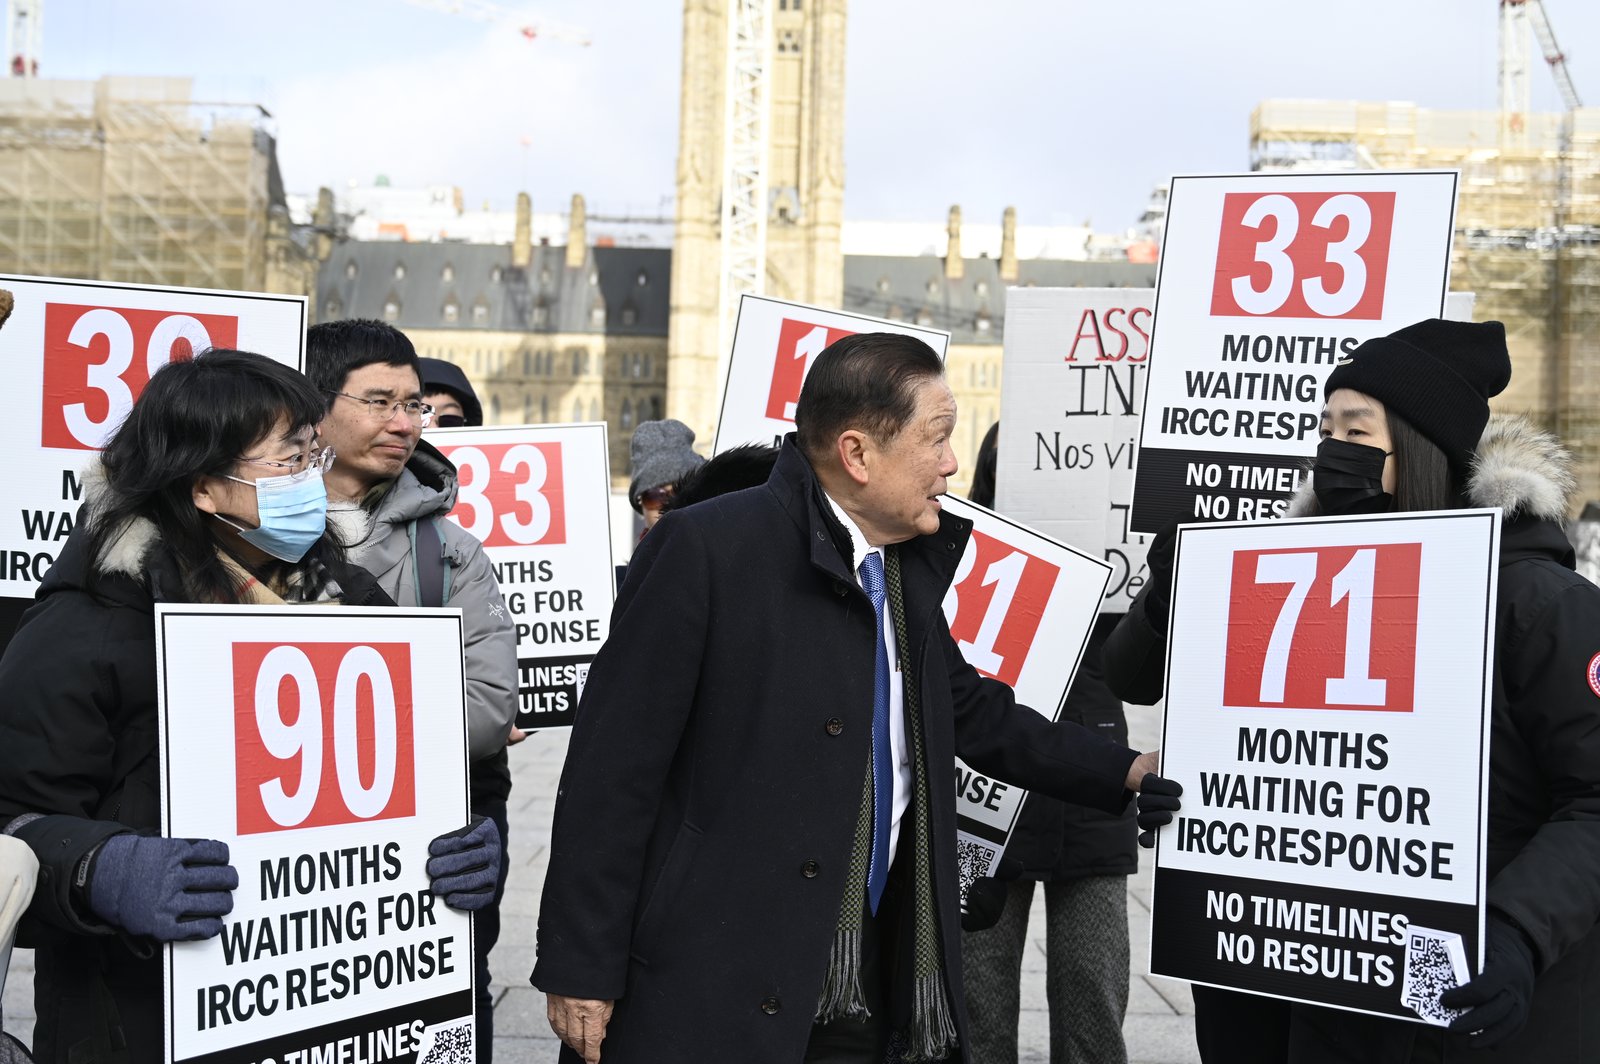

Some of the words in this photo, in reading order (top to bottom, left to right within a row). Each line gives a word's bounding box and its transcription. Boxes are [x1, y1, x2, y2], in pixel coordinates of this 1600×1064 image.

[1231, 194, 1372, 316] 33
[1221, 334, 1359, 365] MONTHS
[1185, 370, 1317, 403] WAITING
[1160, 406, 1229, 437] IRCC
[1034, 431, 1093, 471] Nos
[1186, 463, 1222, 487] NO
[447, 444, 551, 544] 33
[1194, 494, 1230, 519] NO
[534, 589, 583, 613] FOR
[516, 619, 601, 645] PONSE
[1255, 548, 1387, 707] 71
[518, 665, 577, 688] LINES
[519, 691, 569, 714] ULTS
[254, 645, 397, 827] 90
[1237, 727, 1389, 771] MONTHS
[1199, 772, 1343, 818] WAITING
[1356, 783, 1431, 826] FOR
[260, 842, 401, 901] MONTHS
[1177, 817, 1249, 858] IRCC
[1254, 828, 1454, 881] RESPONSE
[219, 901, 368, 965] WAITING
[378, 890, 436, 937] FOR
[1206, 889, 1244, 922] NO
[1251, 895, 1410, 947] TIMELINES
[197, 973, 279, 1031] IRCC
[285, 935, 455, 1010] RESPONSE
[1216, 931, 1255, 965] NO
[1263, 938, 1395, 987] RESULTS
